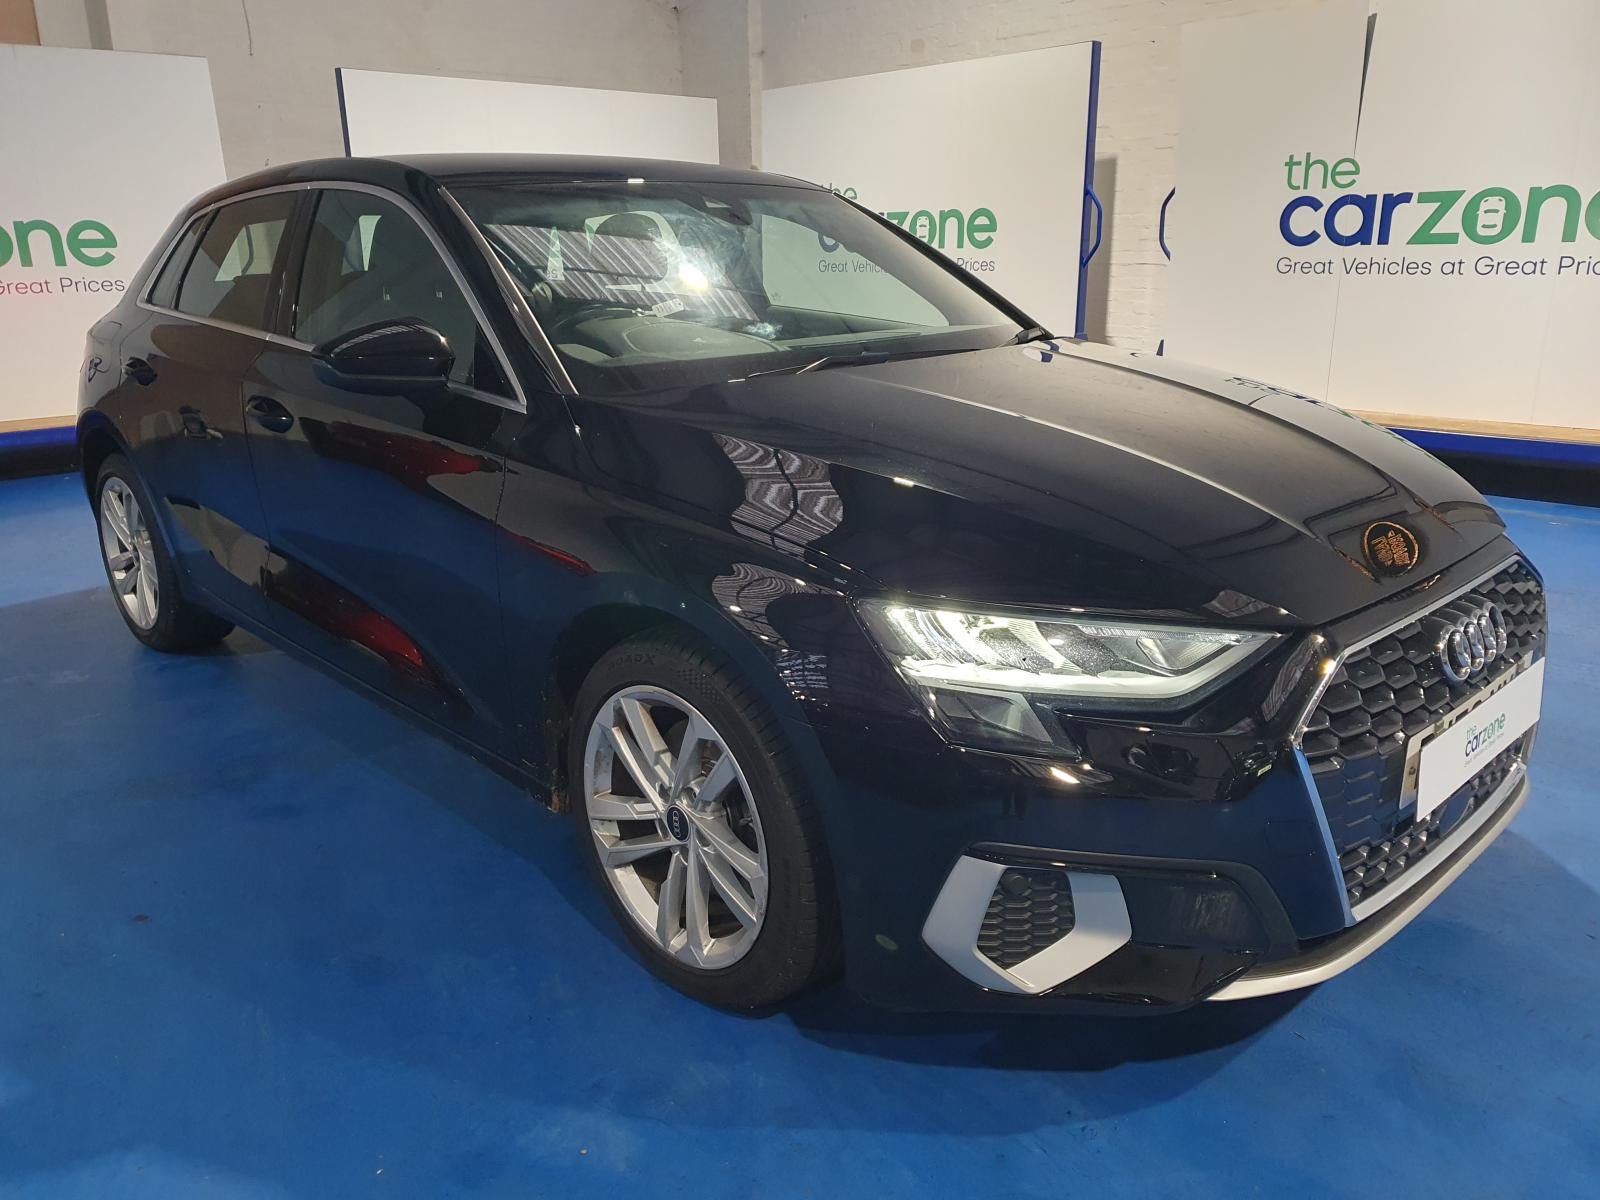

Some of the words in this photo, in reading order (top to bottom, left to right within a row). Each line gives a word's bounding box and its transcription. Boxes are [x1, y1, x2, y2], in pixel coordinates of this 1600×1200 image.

[1284, 152, 1361, 190] the
[1279, 184, 1600, 247] carzon
[818, 259, 849, 273] Great
[1276, 256, 1334, 275] Great
[1342, 256, 1432, 276] Vehicles
[1440, 258, 1466, 276] at
[1474, 255, 1548, 276] Great
[59, 276, 126, 294] Prices
[1464, 713, 1506, 757] carzone
